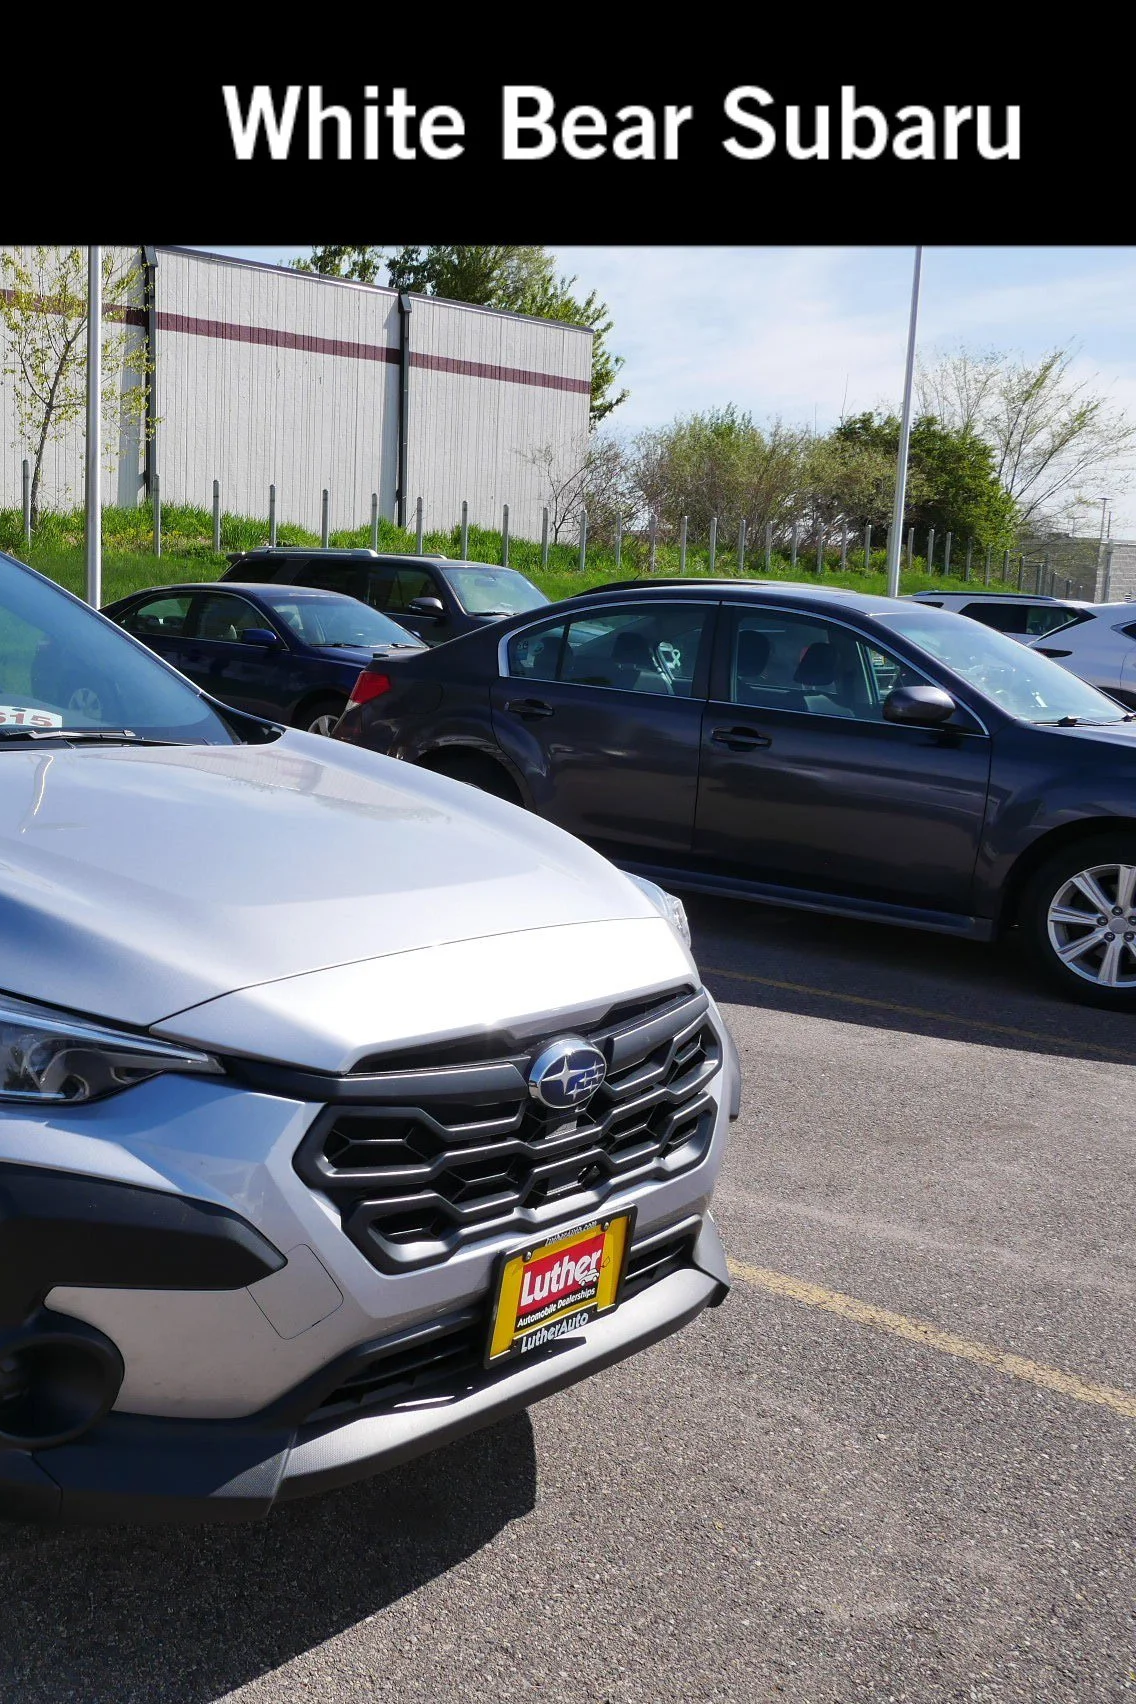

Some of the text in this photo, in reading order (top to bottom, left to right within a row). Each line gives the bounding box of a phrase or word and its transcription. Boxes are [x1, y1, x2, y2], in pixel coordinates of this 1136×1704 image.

[520, 1249, 602, 1307] Luther
[517, 1287, 596, 1328] Automobile Dealerships
[520, 1312, 589, 1354] LutherAuto
